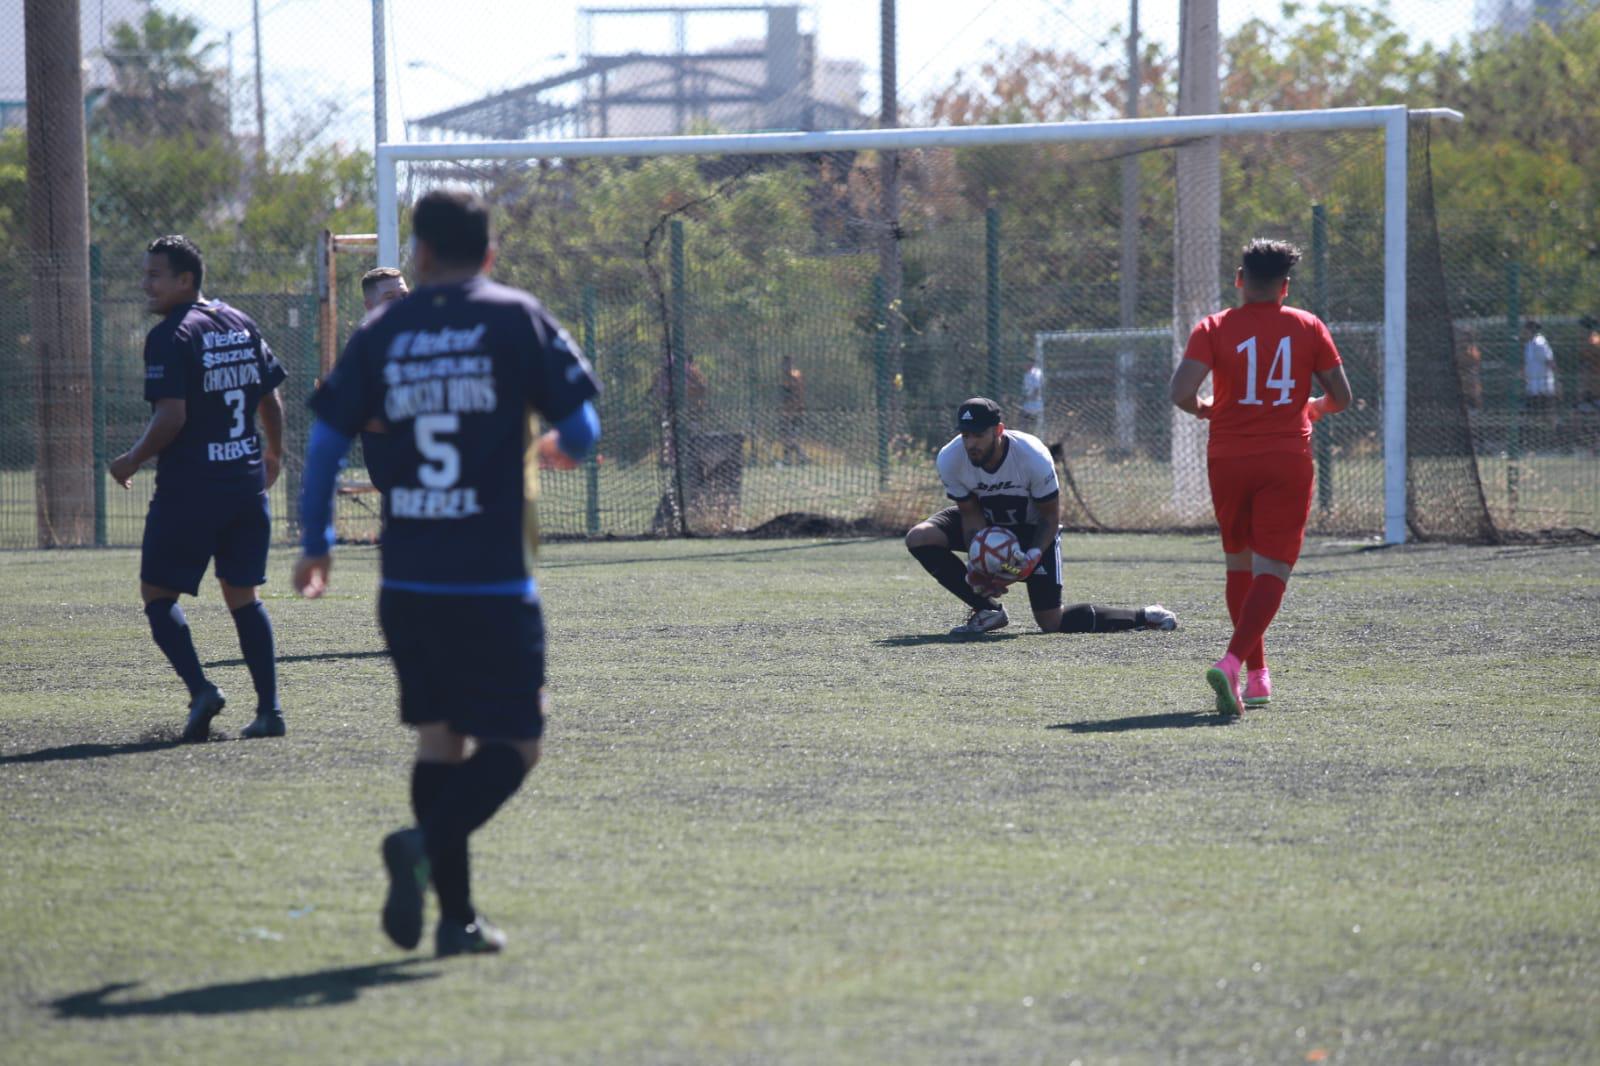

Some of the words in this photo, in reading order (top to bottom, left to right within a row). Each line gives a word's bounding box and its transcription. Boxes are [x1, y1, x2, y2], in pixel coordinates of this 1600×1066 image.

[1236, 335, 1296, 407] 14
[223, 388, 246, 439] 3
[414, 412, 461, 490] 5
